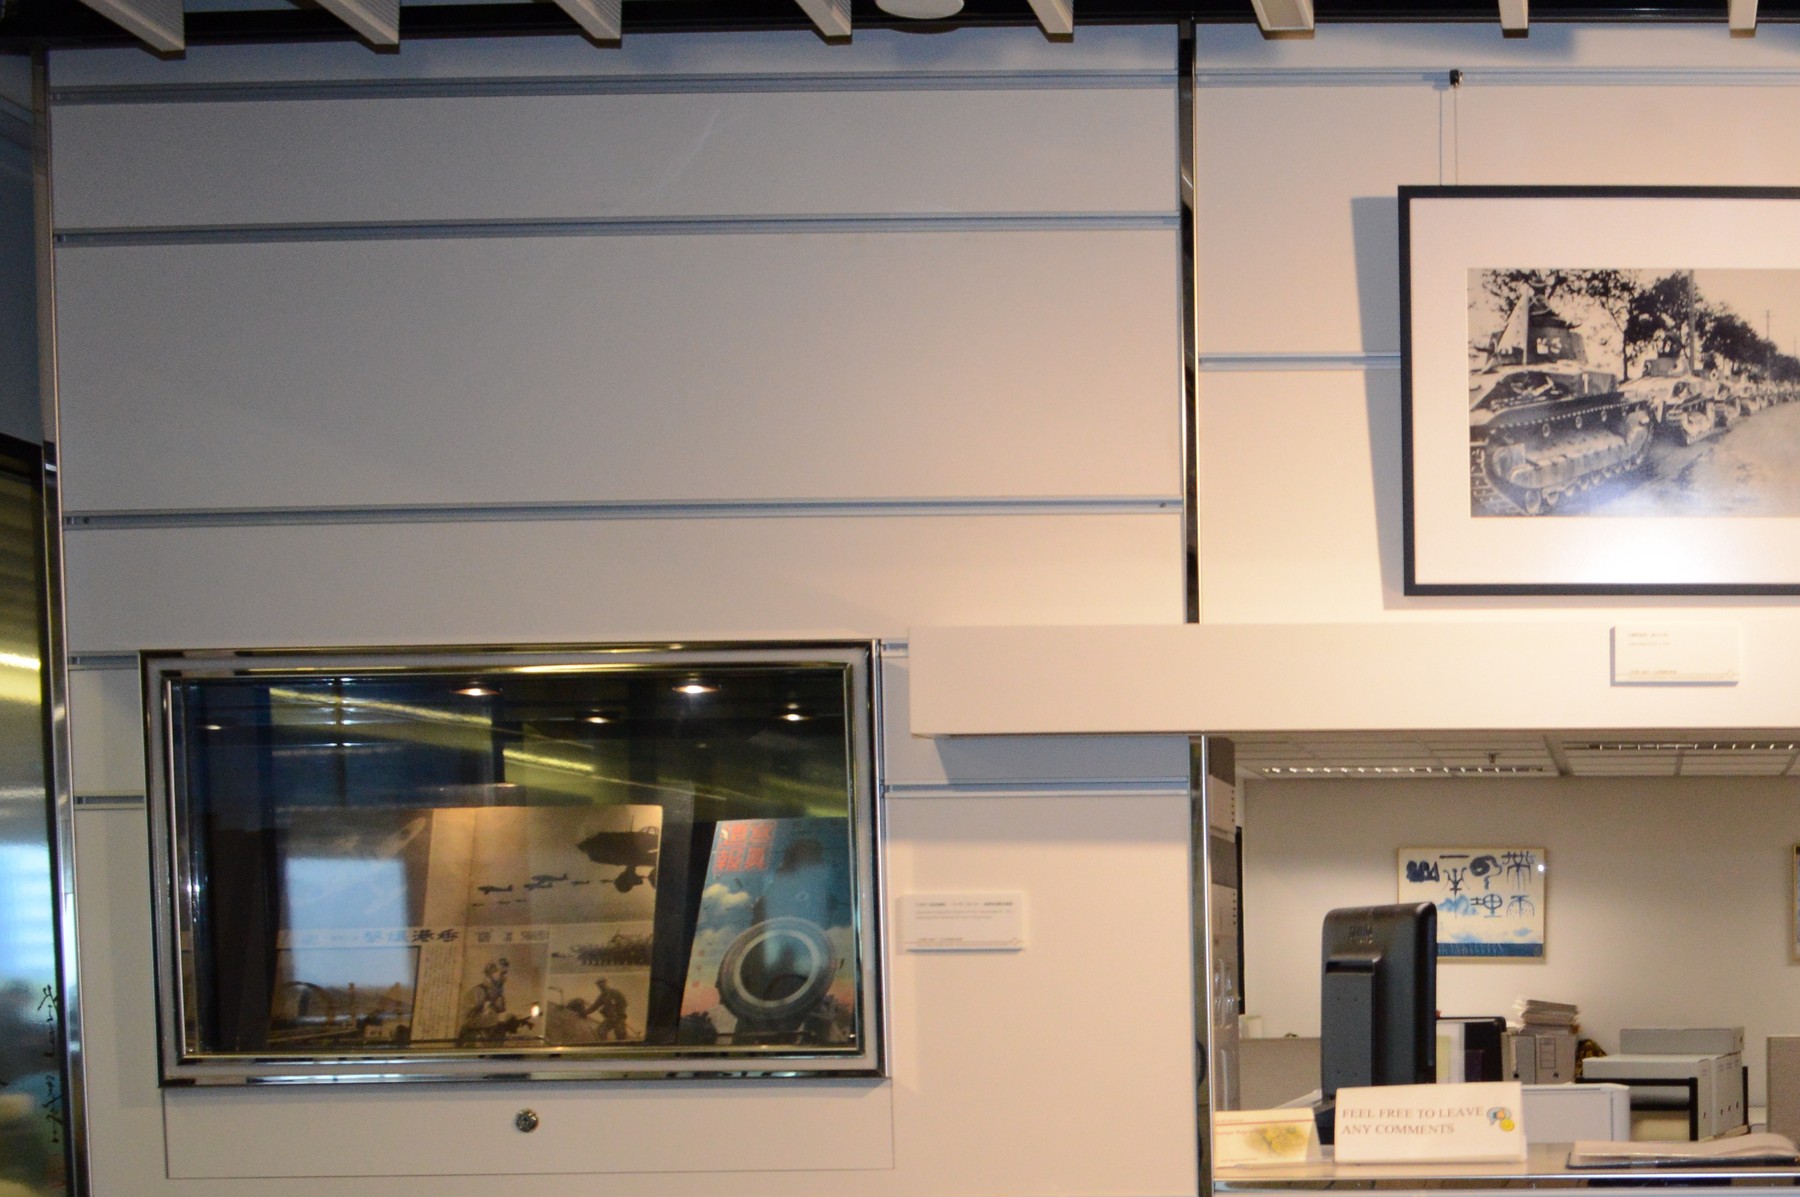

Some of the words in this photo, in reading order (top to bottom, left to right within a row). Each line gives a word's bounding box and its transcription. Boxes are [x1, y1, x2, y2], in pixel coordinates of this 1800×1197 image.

[1341, 1108, 1375, 1119] FEEL
[1378, 1108, 1413, 1119] FREE
[1417, 1108, 1439, 1119] TO
[1442, 1106, 1484, 1118] LEAVE
[1341, 1125, 1371, 1135] ANY
[1375, 1123, 1455, 1135] COMMENTS
